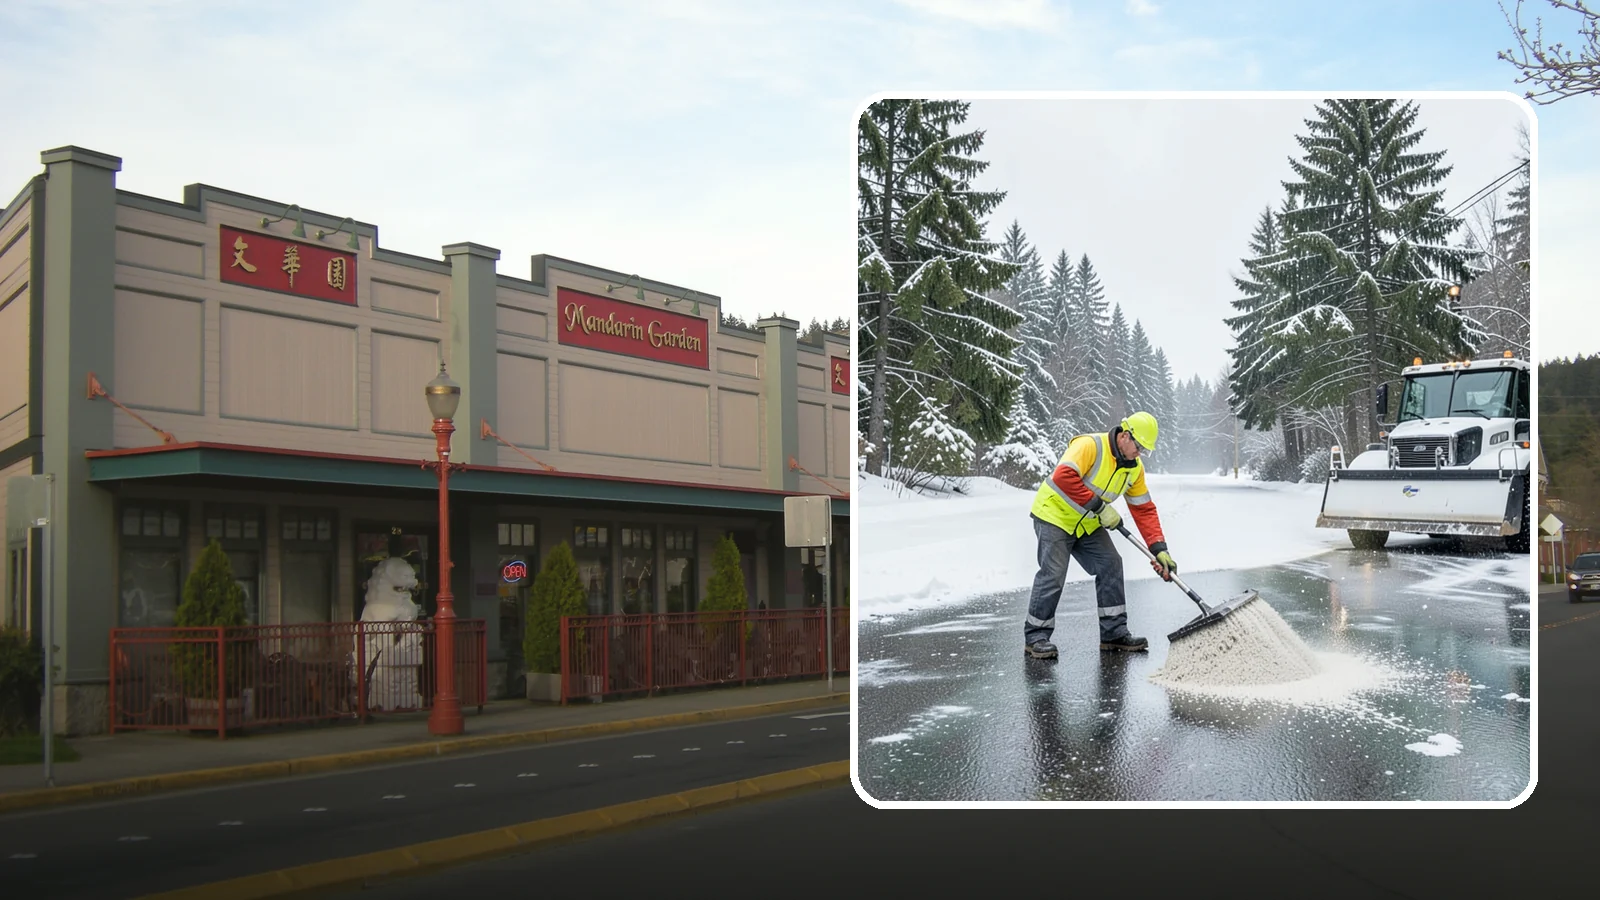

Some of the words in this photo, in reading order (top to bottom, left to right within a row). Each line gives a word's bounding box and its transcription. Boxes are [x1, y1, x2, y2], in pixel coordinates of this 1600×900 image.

[564, 302, 644, 341] Mandarin
[647, 320, 702, 352] Garden
[503, 565, 527, 578] OPEN
